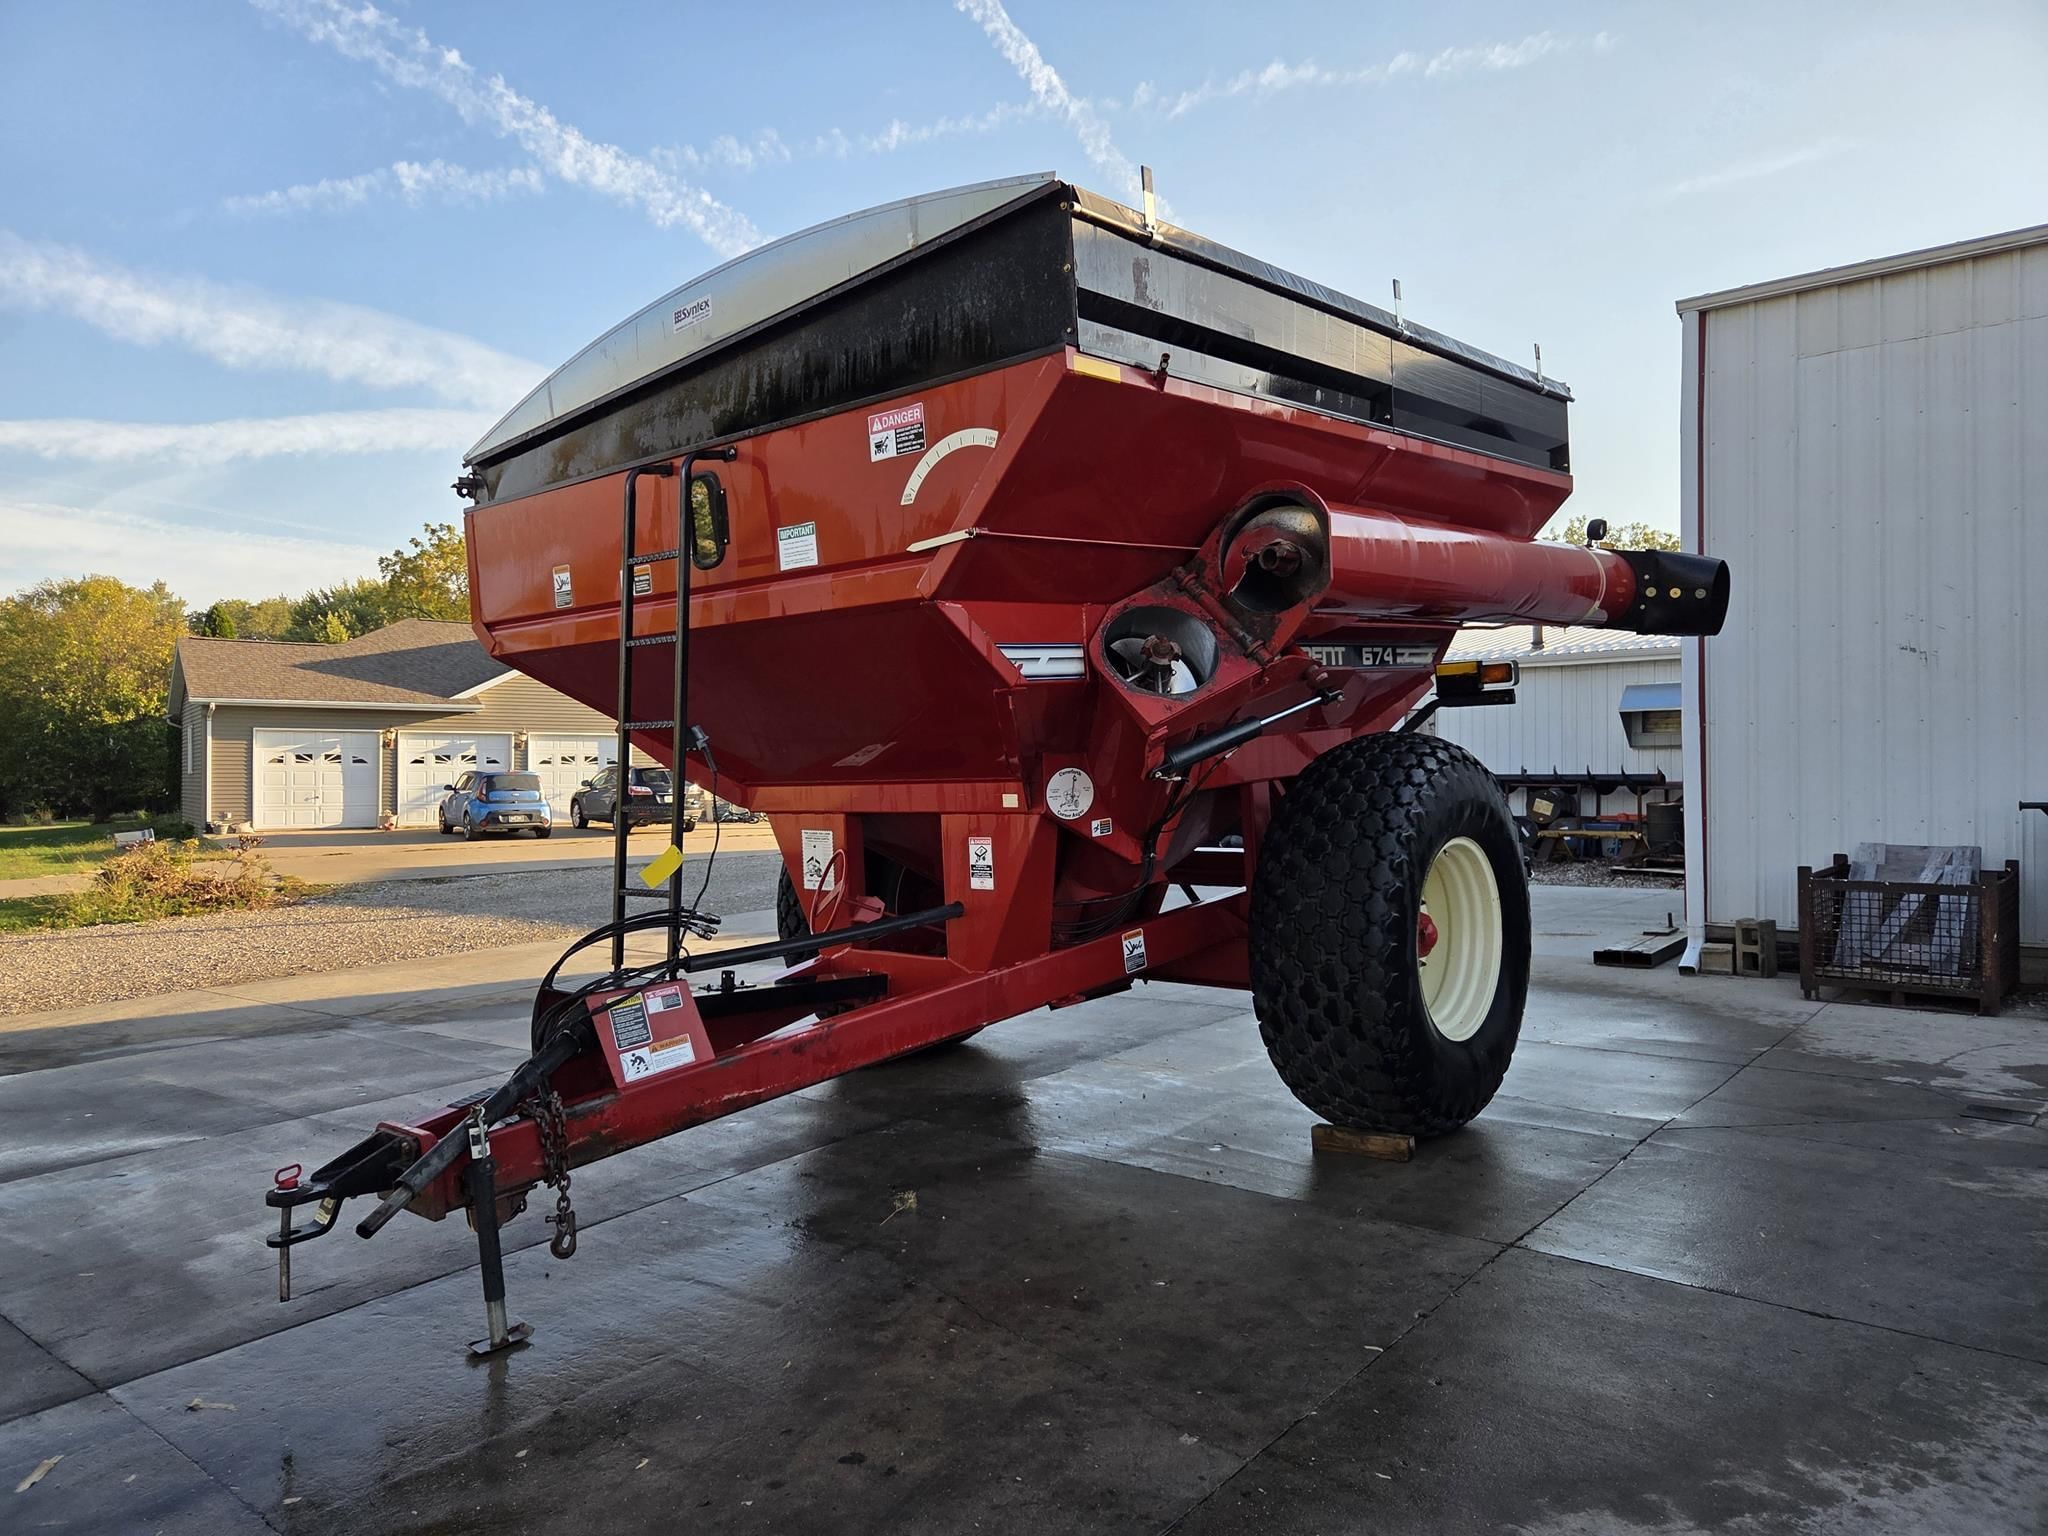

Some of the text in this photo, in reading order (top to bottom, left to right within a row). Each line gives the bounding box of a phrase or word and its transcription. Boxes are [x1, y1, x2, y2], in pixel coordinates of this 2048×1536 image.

[881, 408, 921, 428] DANGER
[780, 525, 813, 540] IMPORTANT
[1362, 647, 1393, 665] 674
[660, 1037, 689, 1048] WARNING
